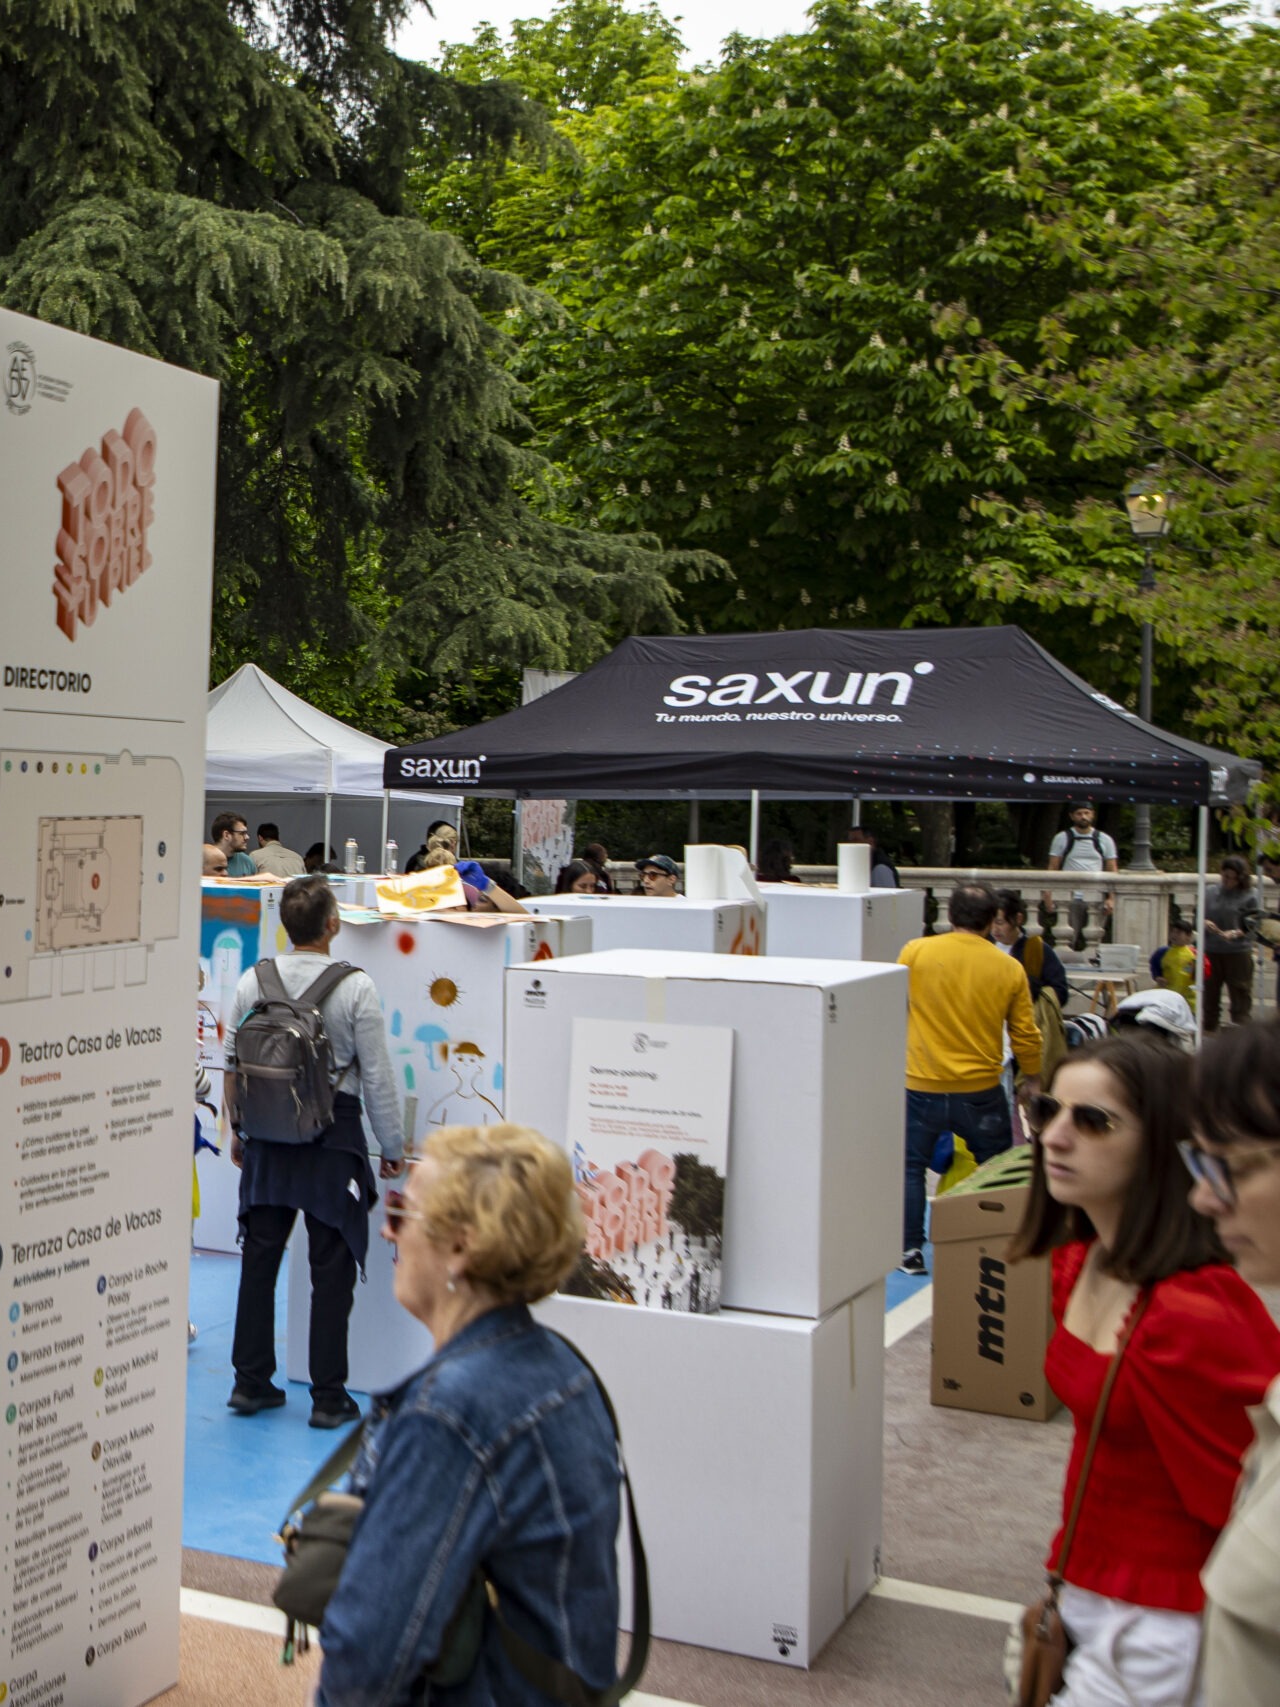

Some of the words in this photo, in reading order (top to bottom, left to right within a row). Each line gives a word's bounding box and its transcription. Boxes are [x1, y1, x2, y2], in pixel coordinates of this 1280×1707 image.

[4, 665, 91, 693] DIRECTORIO
[663, 669, 915, 707] saxun
[655, 712, 673, 722] Tu
[745, 710, 815, 722] nuestro
[400, 757, 481, 778] saxun
[1041, 774, 1104, 785] saxun.com
[19, 1041, 64, 1064] Teatro
[67, 1035, 102, 1056] Casa
[106, 1028, 122, 1050] de
[126, 1026, 162, 1046] Vacas
[21, 1072, 62, 1087] Encuentros
[23, 1100, 48, 1113] Hábitos
[82, 1091, 96, 1104] para
[22, 1113, 43, 1126] cuidar
[31, 1147, 47, 1159] cada
[48, 1143, 66, 1155] etapa
[67, 1140, 75, 1151] de
[11, 1235, 63, 1265] Terraza
[66, 1226, 102, 1249] Casa
[105, 1215, 122, 1239] de
[125, 1208, 162, 1232] Vacas
[13, 1266, 56, 1288] Actividades
[57, 1266, 62, 1278] y
[64, 1256, 90, 1273] talleres
[108, 1269, 133, 1289] Carpa
[145, 1258, 168, 1277] Roche
[22, 1296, 54, 1316] Terraza
[975, 1256, 1006, 1366] mtn
[21, 1345, 52, 1366] Terraza
[54, 1333, 85, 1355] trasera
[19, 1394, 52, 1418] Carpas
[18, 1417, 34, 1438] Piel
[36, 1410, 58, 1431] Sana
[9, 1668, 38, 1695] Carpa
